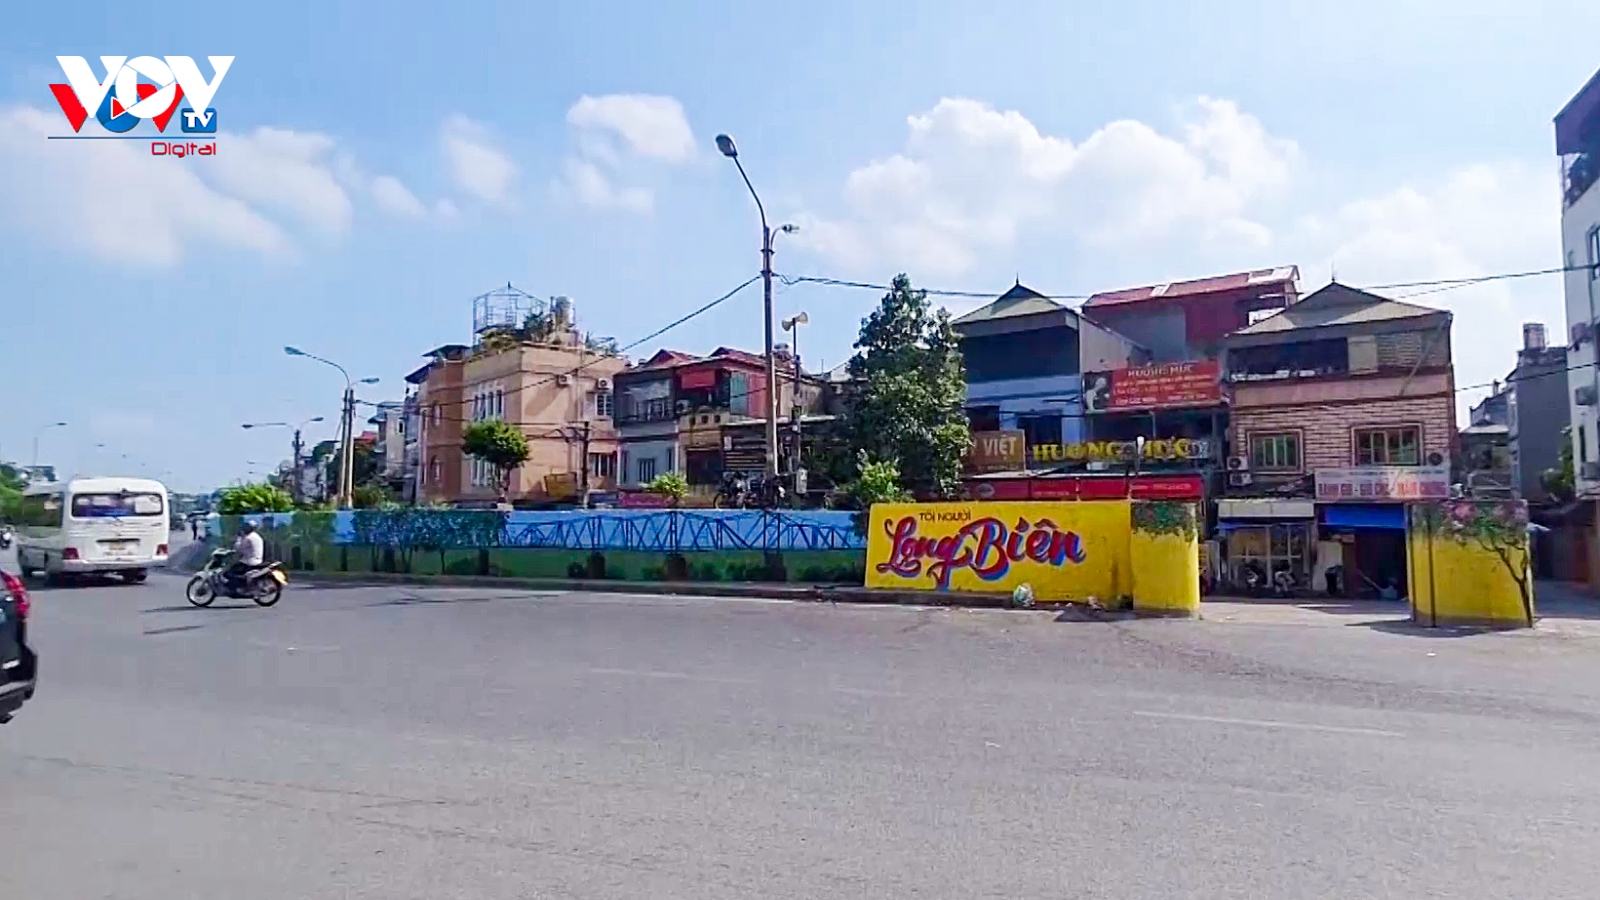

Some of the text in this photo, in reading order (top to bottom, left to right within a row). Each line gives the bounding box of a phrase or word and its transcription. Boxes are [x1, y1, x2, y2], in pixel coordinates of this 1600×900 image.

[983, 434, 1017, 460] VIỆT
[876, 516, 1087, 592] Long Biên
